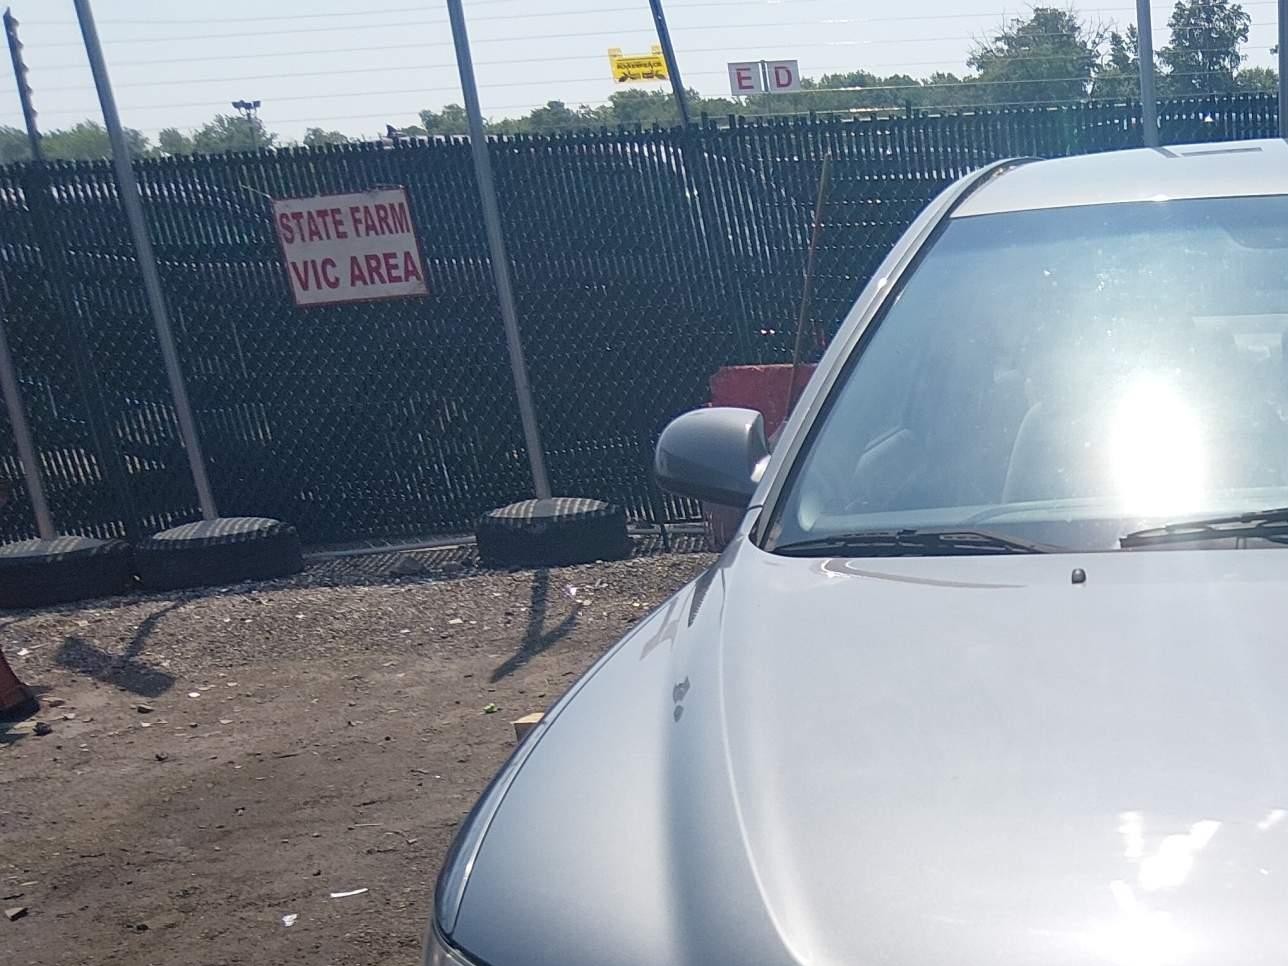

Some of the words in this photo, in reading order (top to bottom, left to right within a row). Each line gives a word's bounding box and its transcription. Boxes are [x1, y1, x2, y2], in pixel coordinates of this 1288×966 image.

[736, 68, 754, 90] E
[774, 66, 793, 88] D
[279, 207, 348, 244] STATE
[349, 202, 411, 238] FARM
[290, 257, 340, 291] VIC
[350, 251, 422, 287] AREA
